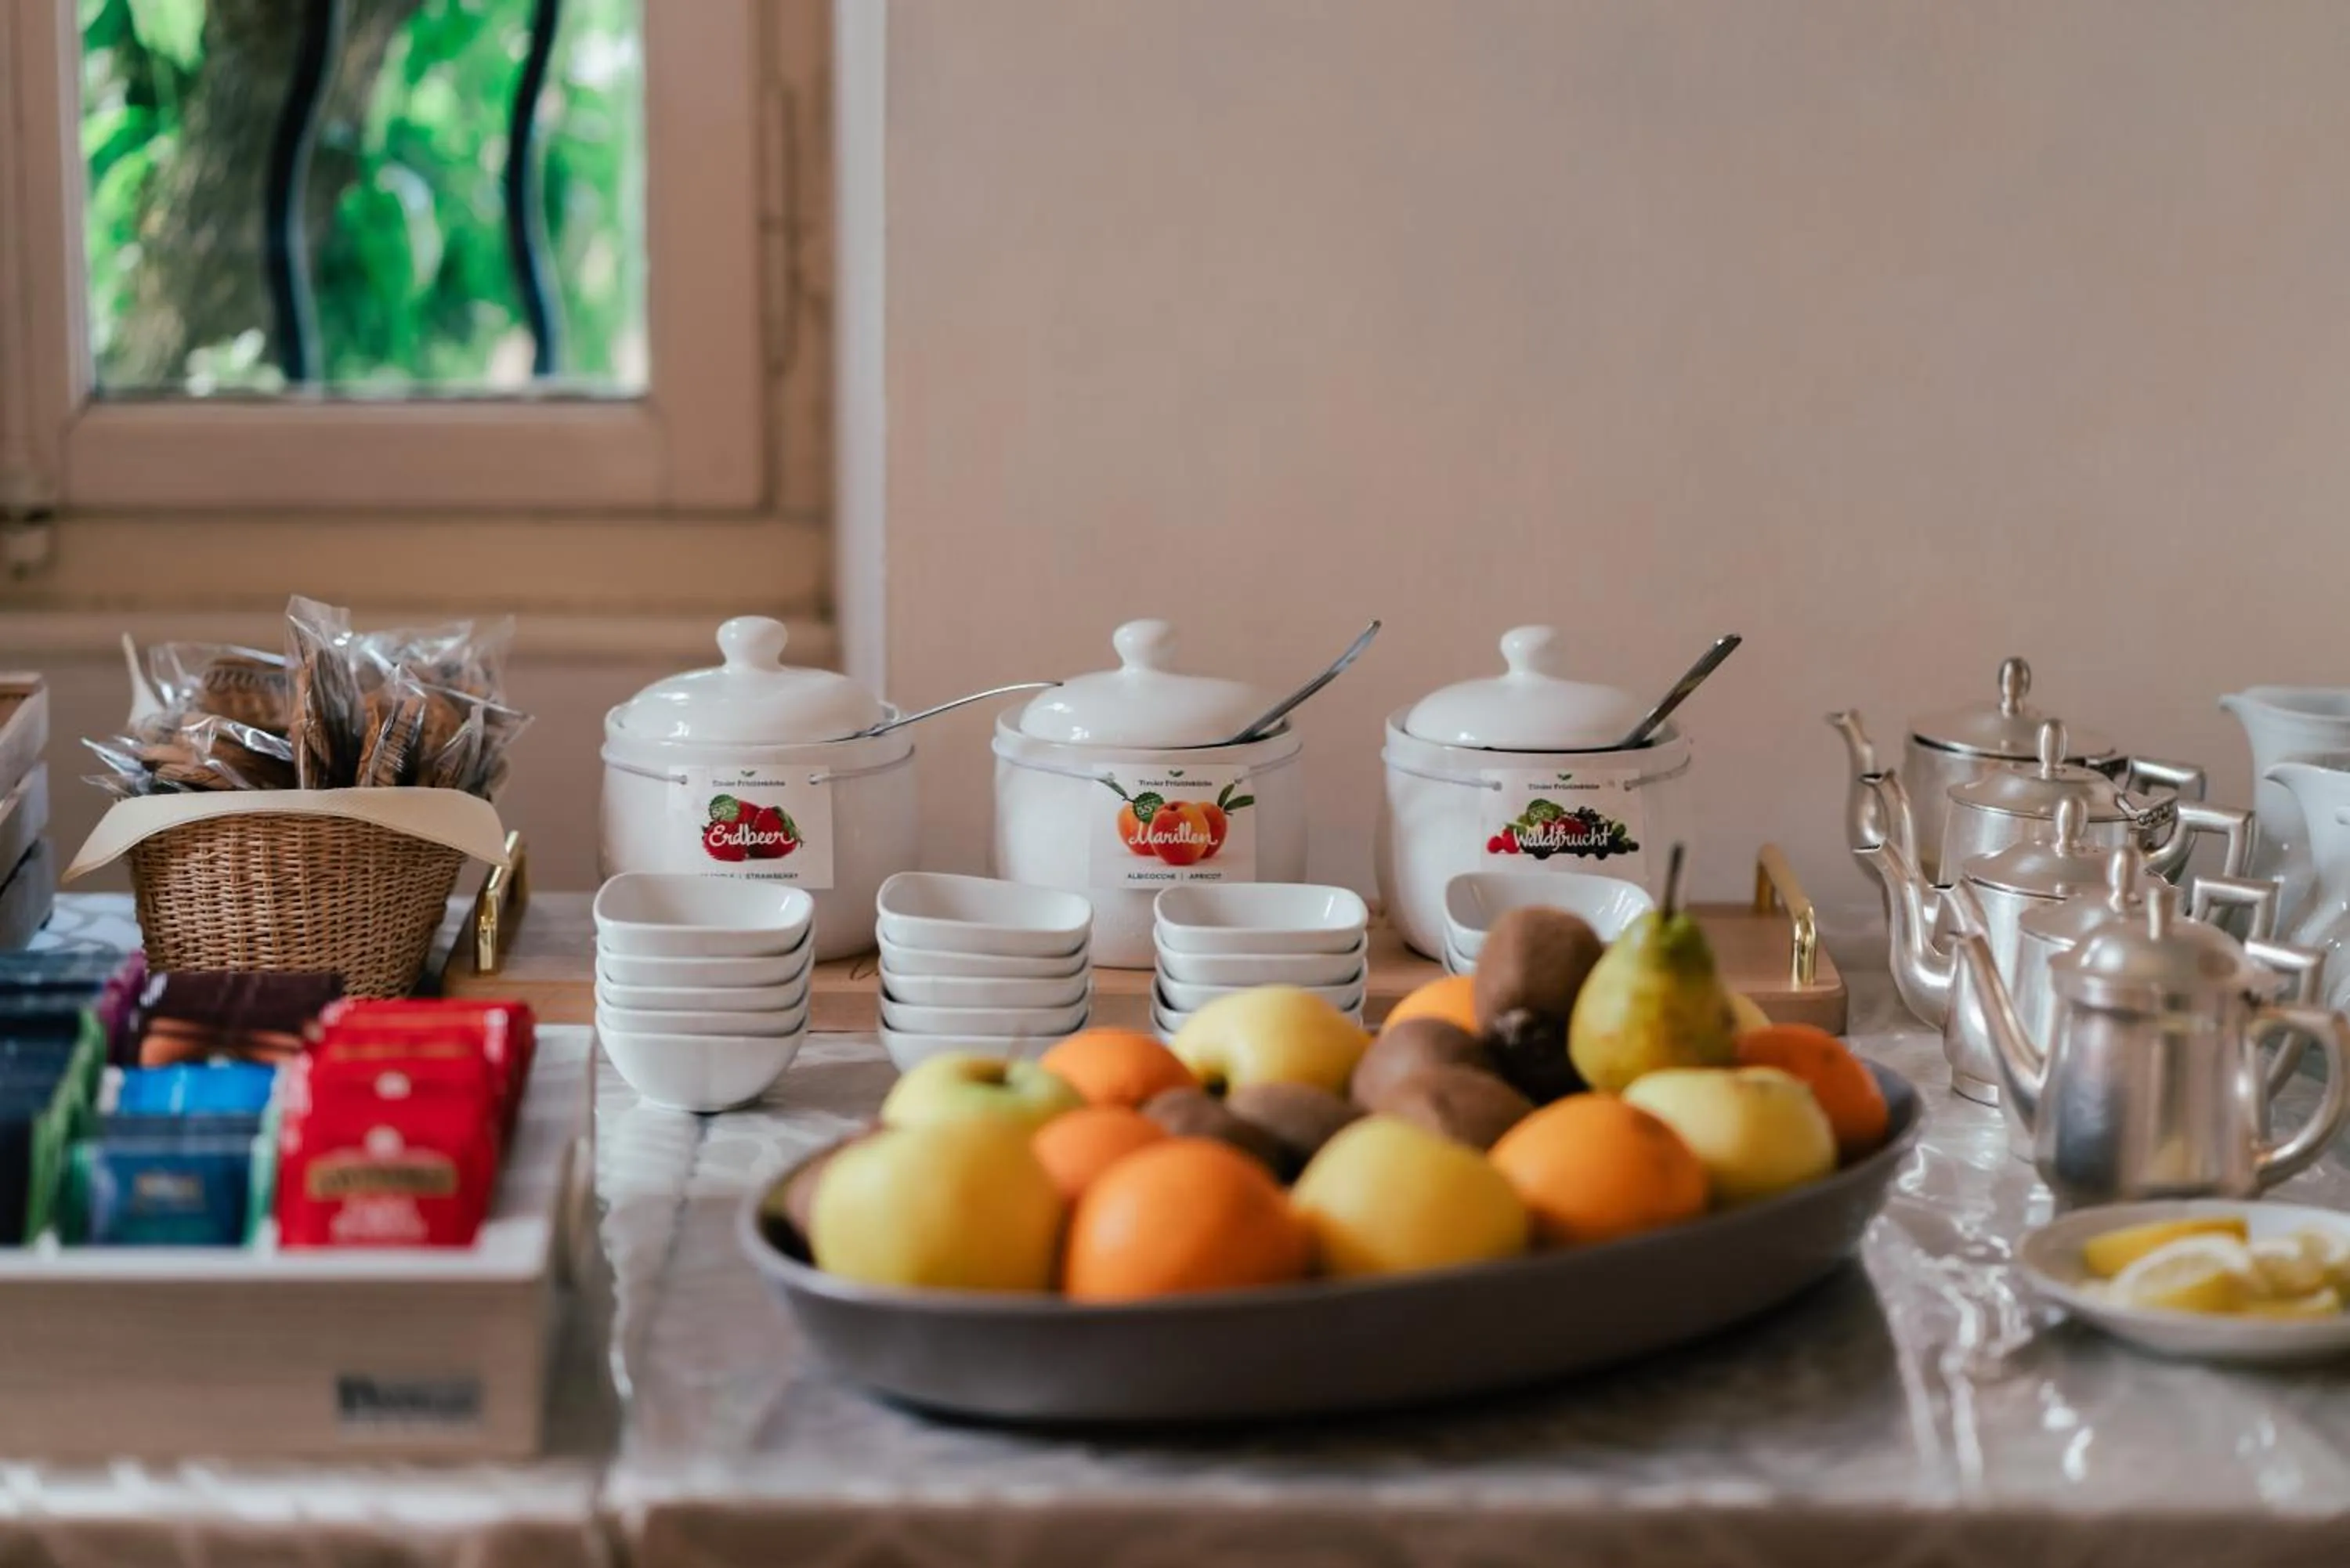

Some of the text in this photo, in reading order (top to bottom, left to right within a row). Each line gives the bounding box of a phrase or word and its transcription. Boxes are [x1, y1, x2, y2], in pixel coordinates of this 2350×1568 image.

[709, 823, 794, 847] Erdbeer
[1128, 821, 1219, 846] Marillen
[1513, 823, 1612, 851] Waldfrucht
